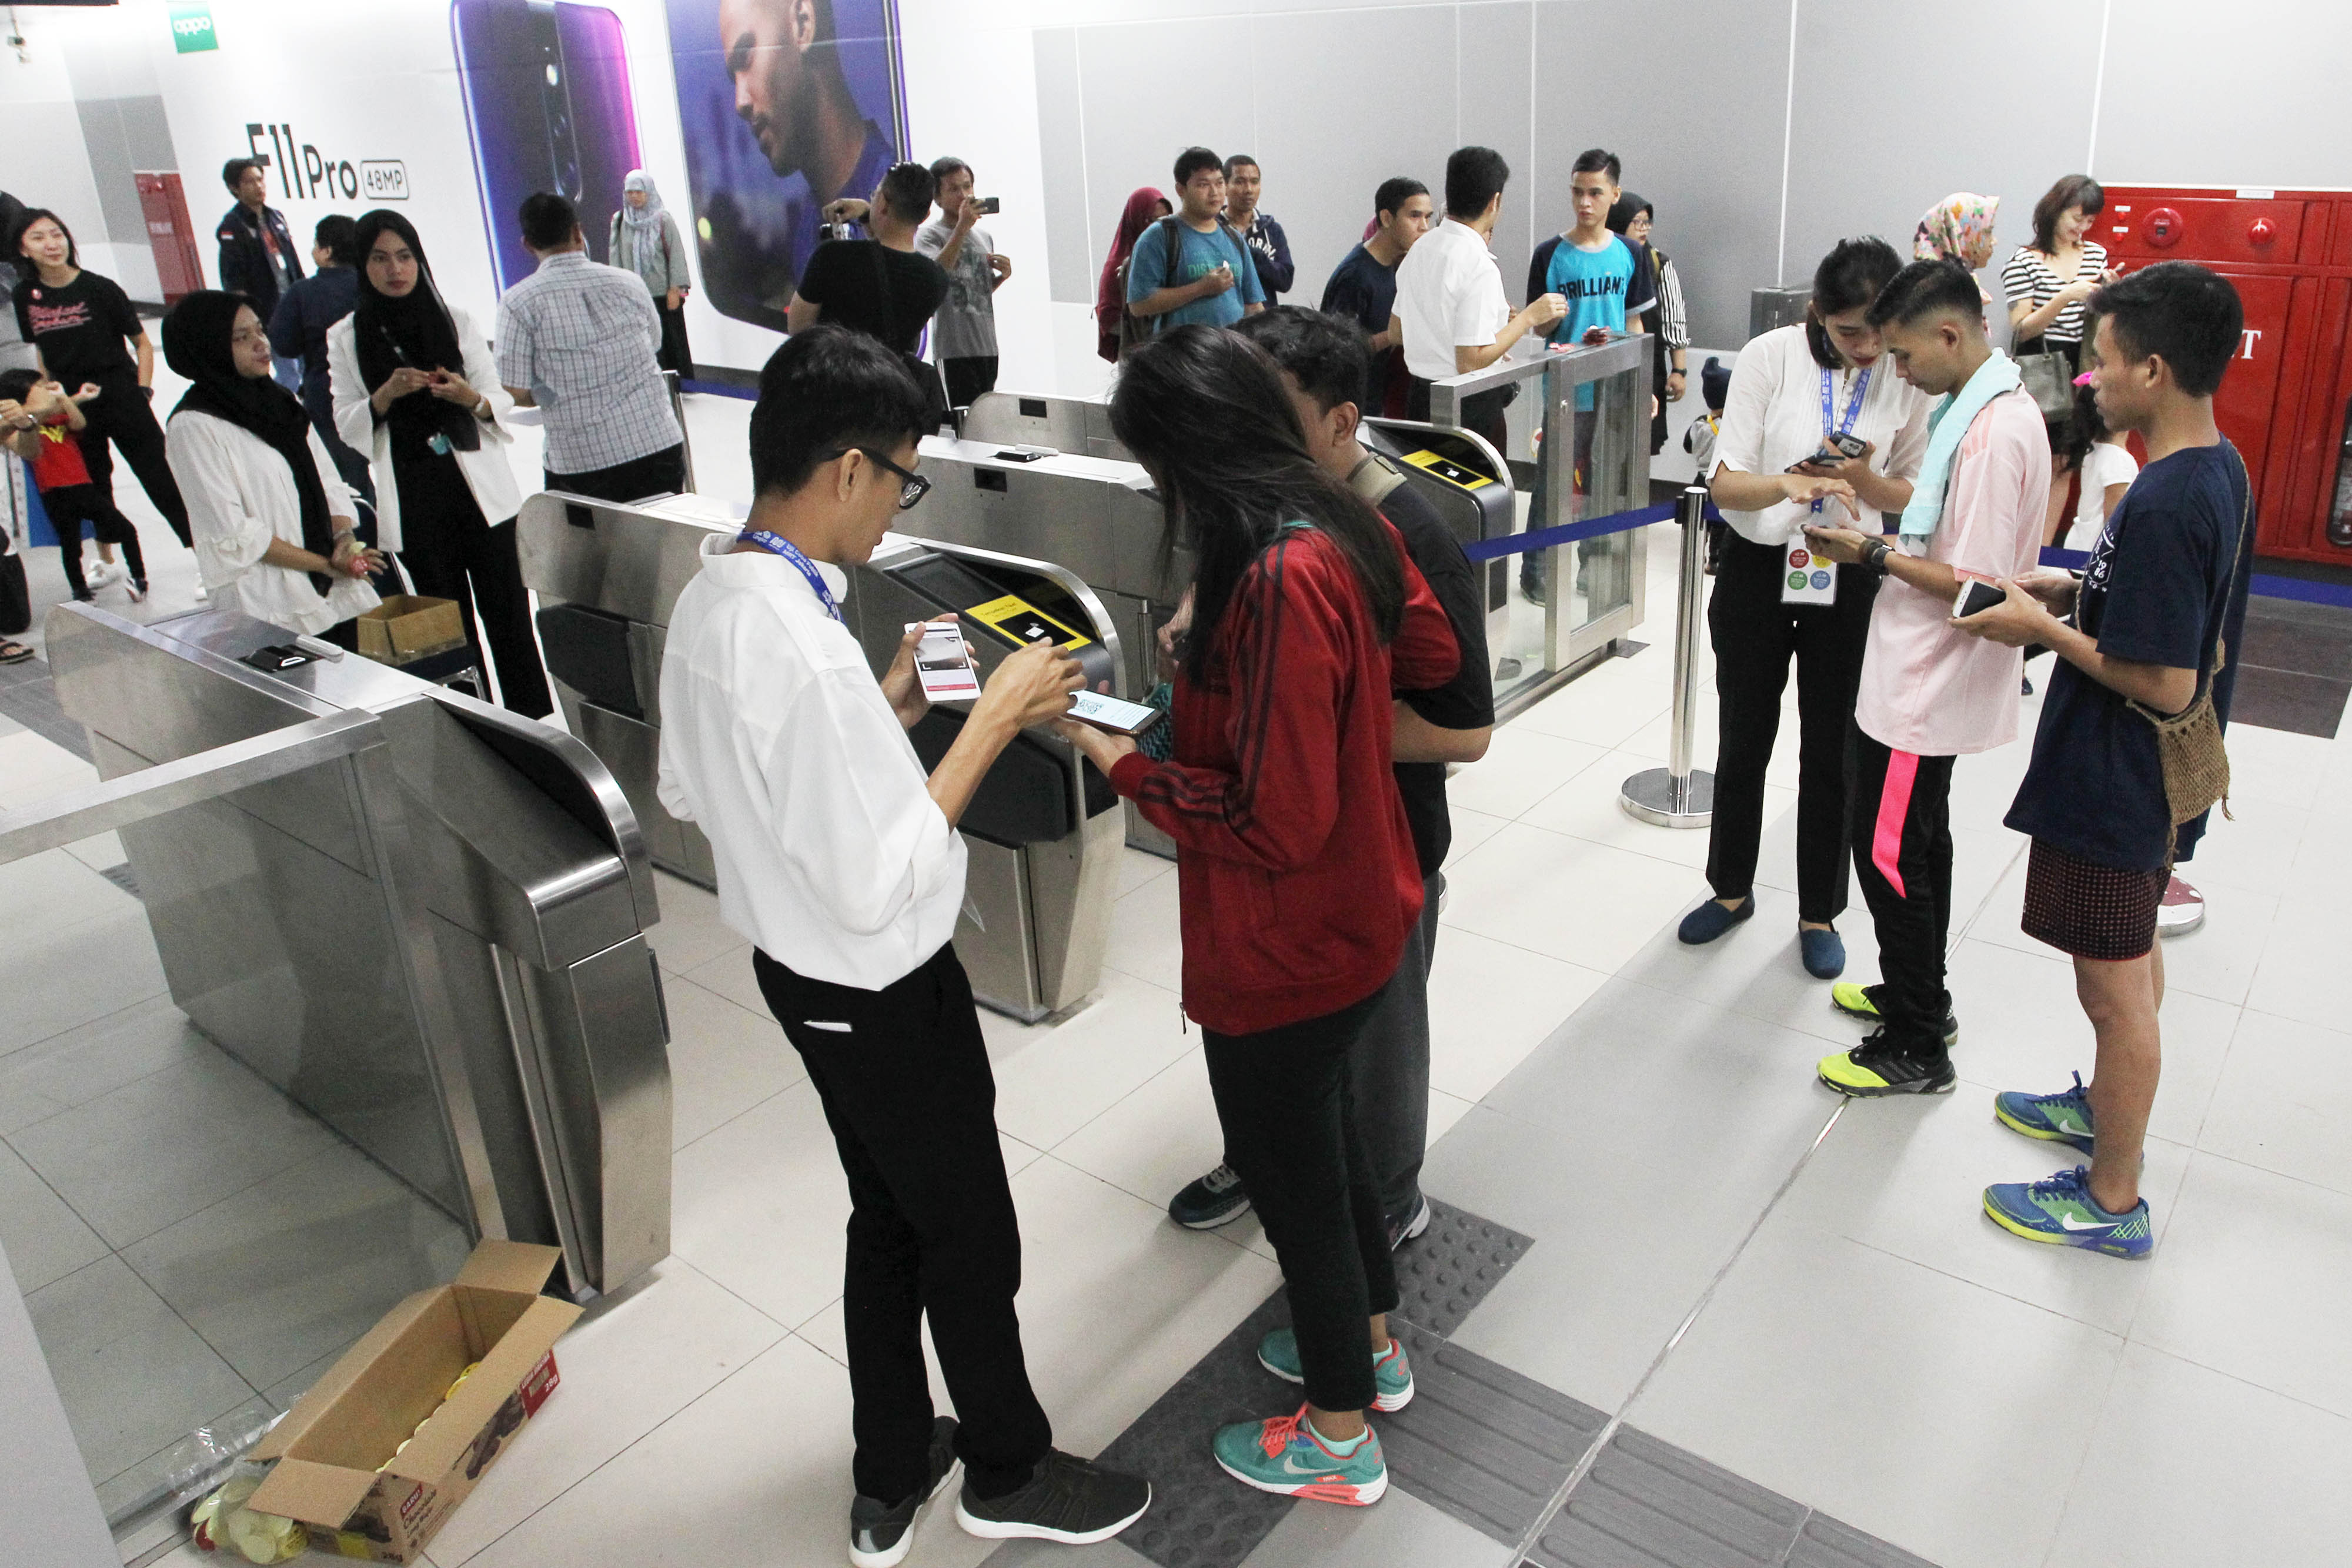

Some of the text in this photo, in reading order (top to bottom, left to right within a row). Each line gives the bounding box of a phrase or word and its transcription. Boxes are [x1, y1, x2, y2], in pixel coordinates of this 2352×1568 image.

[302, 144, 358, 200] Pro
[366, 169, 403, 191] 48MP
[2098, 560, 2107, 570] 19
